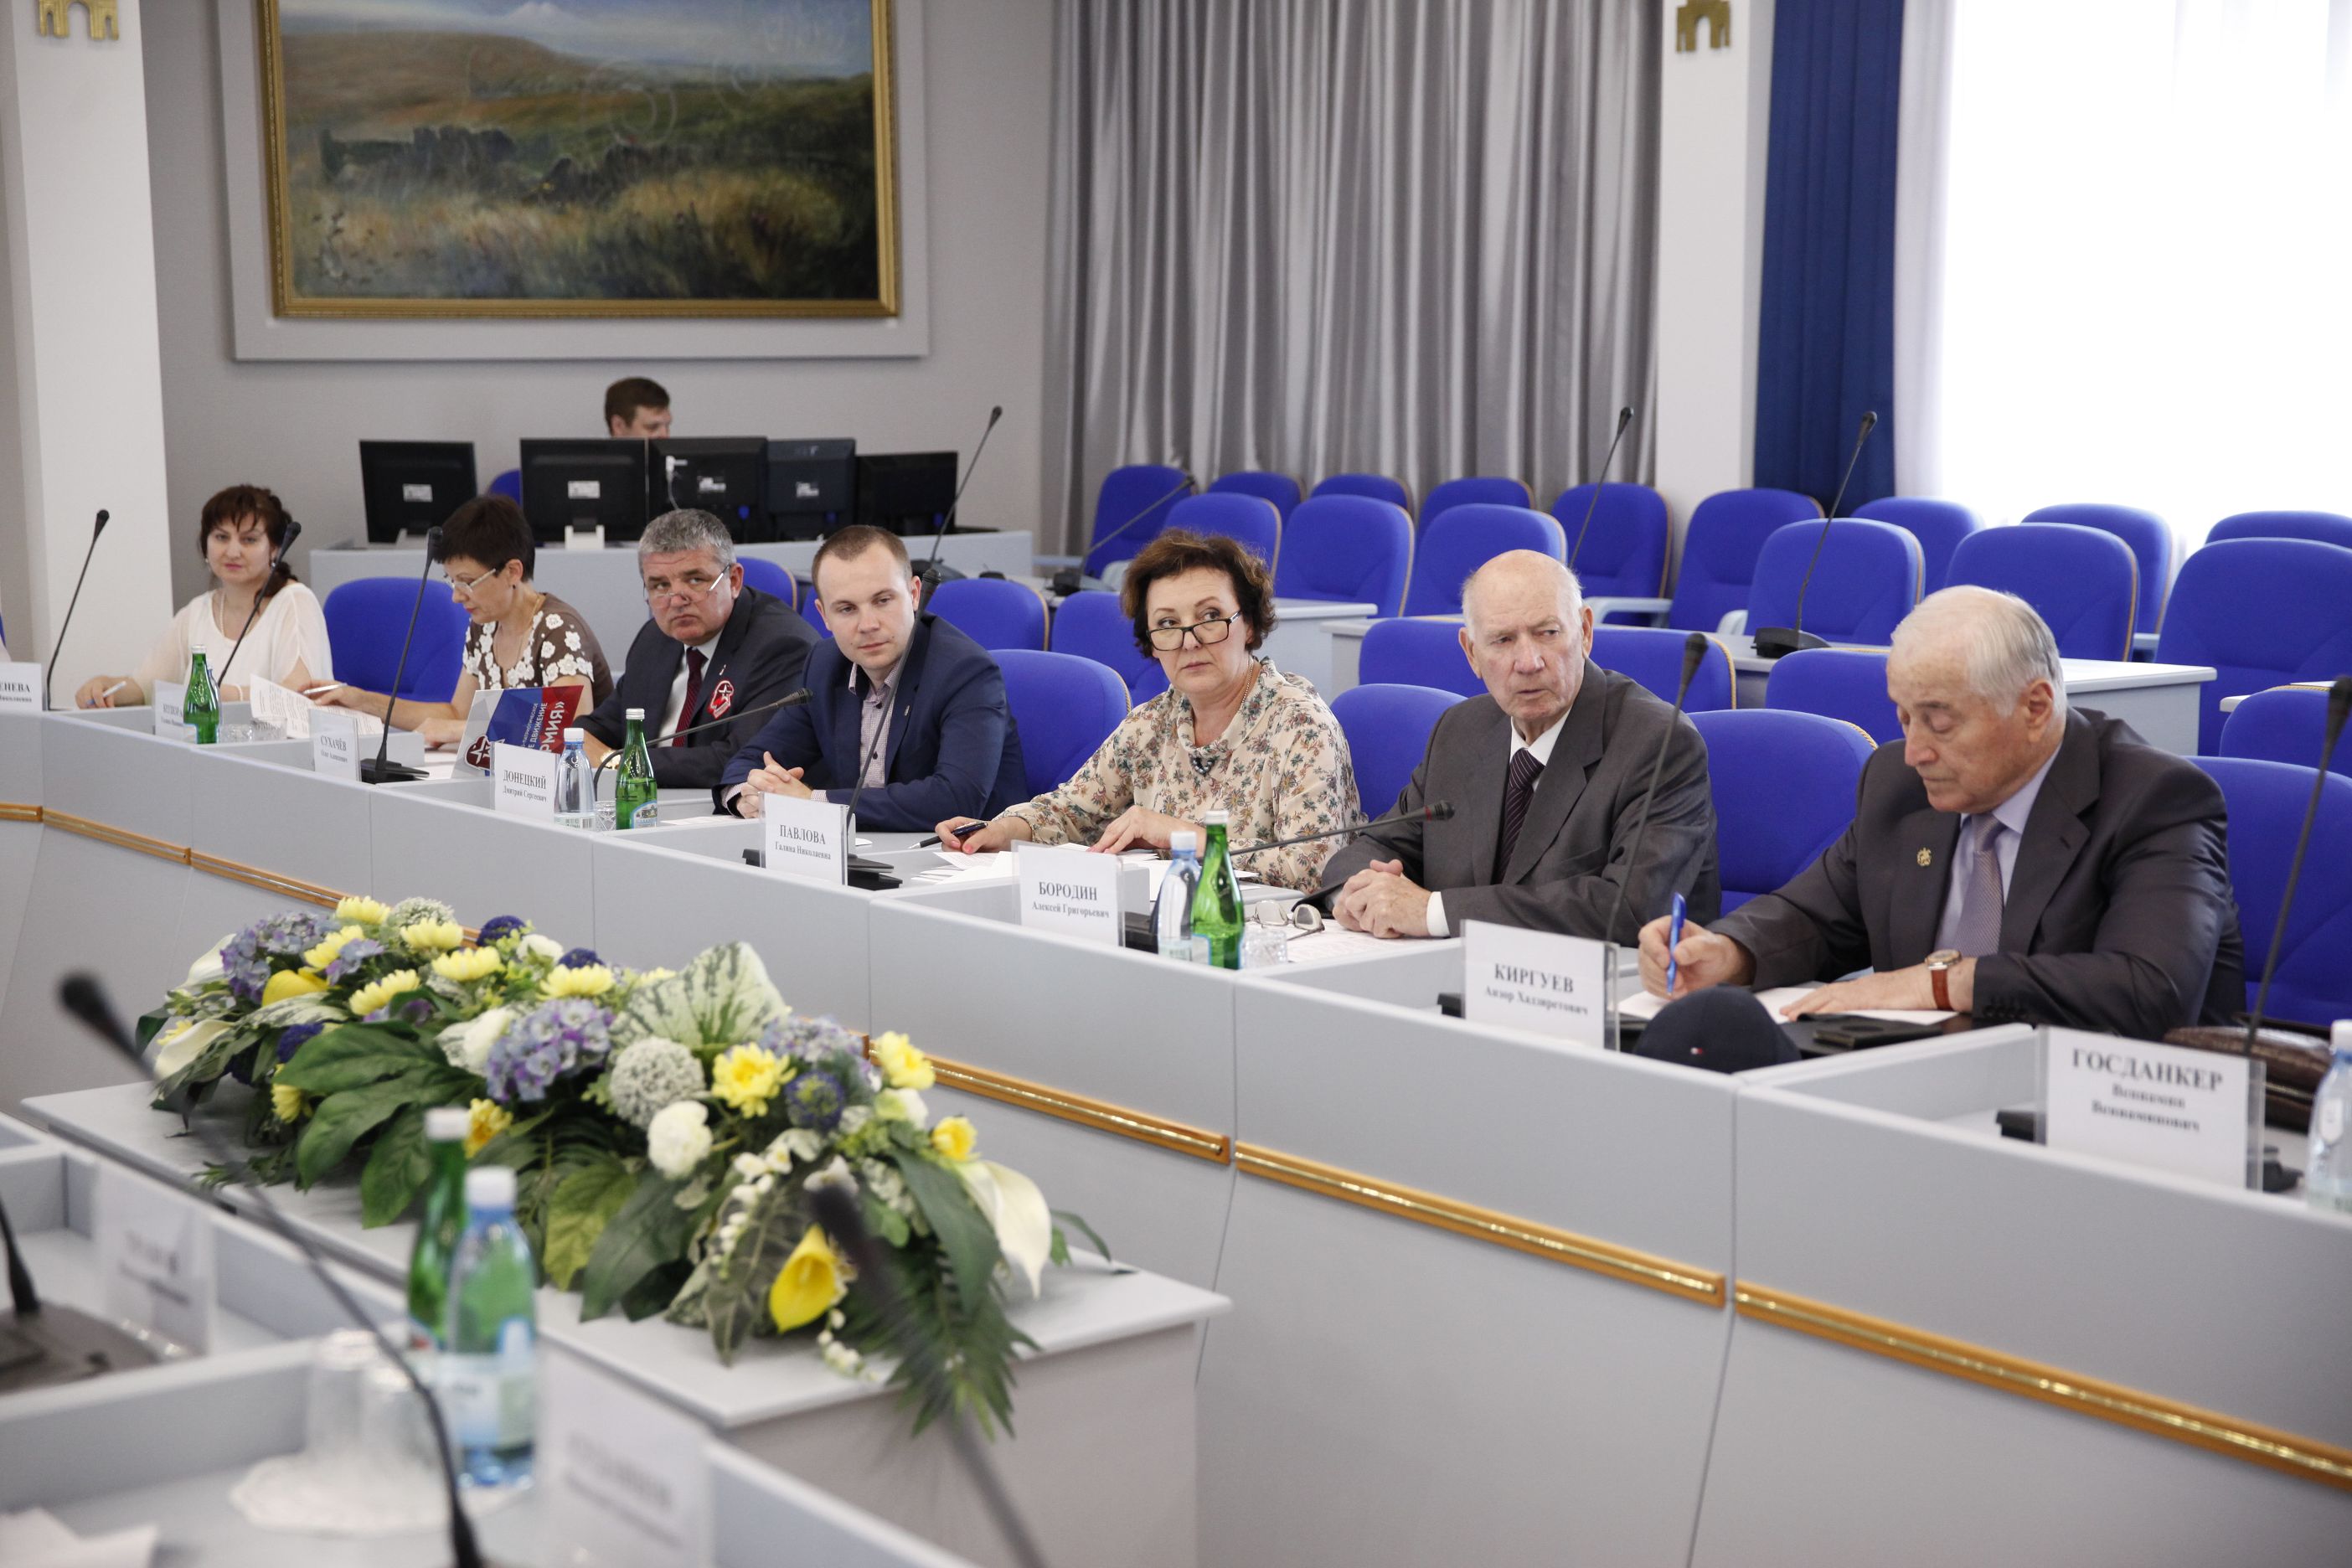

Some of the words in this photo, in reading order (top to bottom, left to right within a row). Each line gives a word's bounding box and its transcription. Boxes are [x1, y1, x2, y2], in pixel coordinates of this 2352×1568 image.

[503, 769, 546, 790] ДОНЕЦКИЙ
[503, 786, 524, 797] Дмитрий
[524, 789, 547, 802] Сергеевич
[780, 824, 826, 845] ПАВЛОВА
[775, 841, 796, 854] Галина
[797, 845, 831, 860] Николаевна
[1039, 881, 1097, 901] БОРОДИН
[1032, 901, 1061, 913] Алексей
[1062, 904, 1110, 918] Григорьевич
[1494, 963, 1574, 993] КИРГУЕВ
[2072, 1048, 2223, 1091] ГОСДАНКЕР
